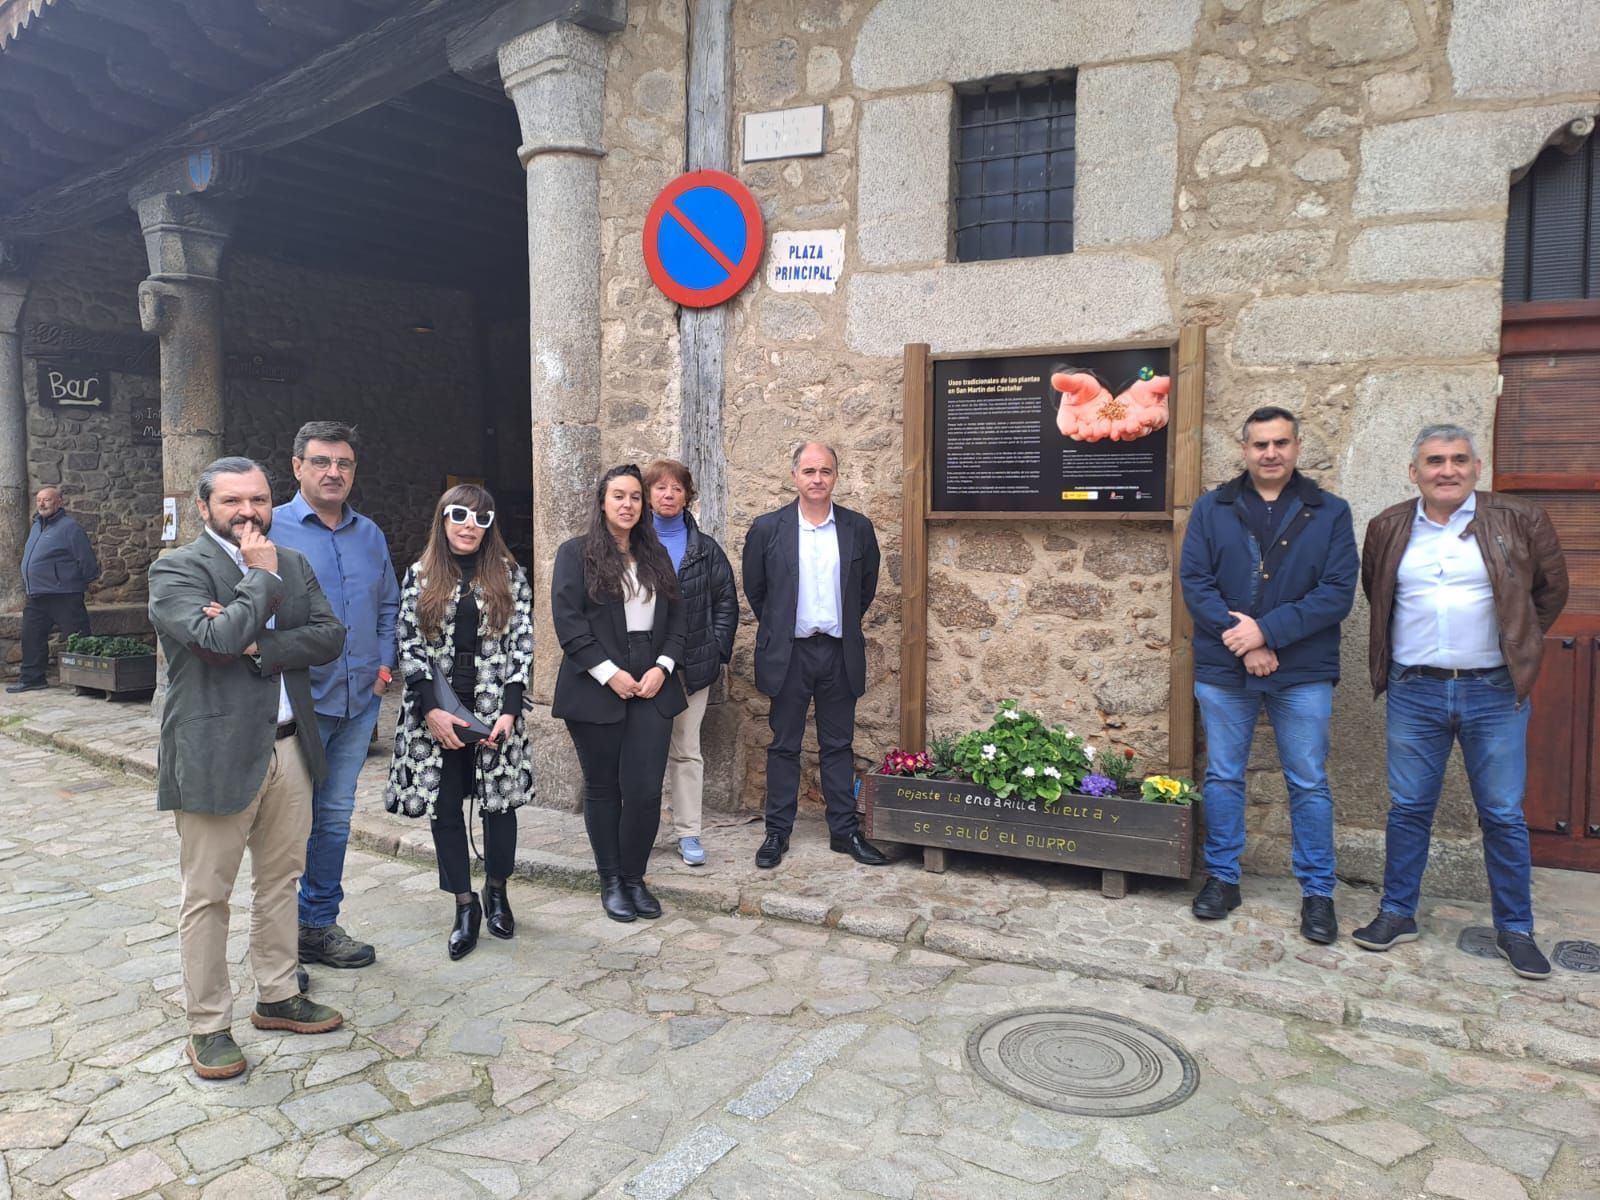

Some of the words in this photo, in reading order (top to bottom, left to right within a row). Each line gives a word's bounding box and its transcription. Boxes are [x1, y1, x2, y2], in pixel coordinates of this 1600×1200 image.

[789, 245, 823, 260] PLAZA
[48, 371, 99, 399] Bar
[963, 377, 999, 386] tradicionales
[1018, 375, 1041, 384] plantas
[1026, 834, 1077, 852] BURRO
